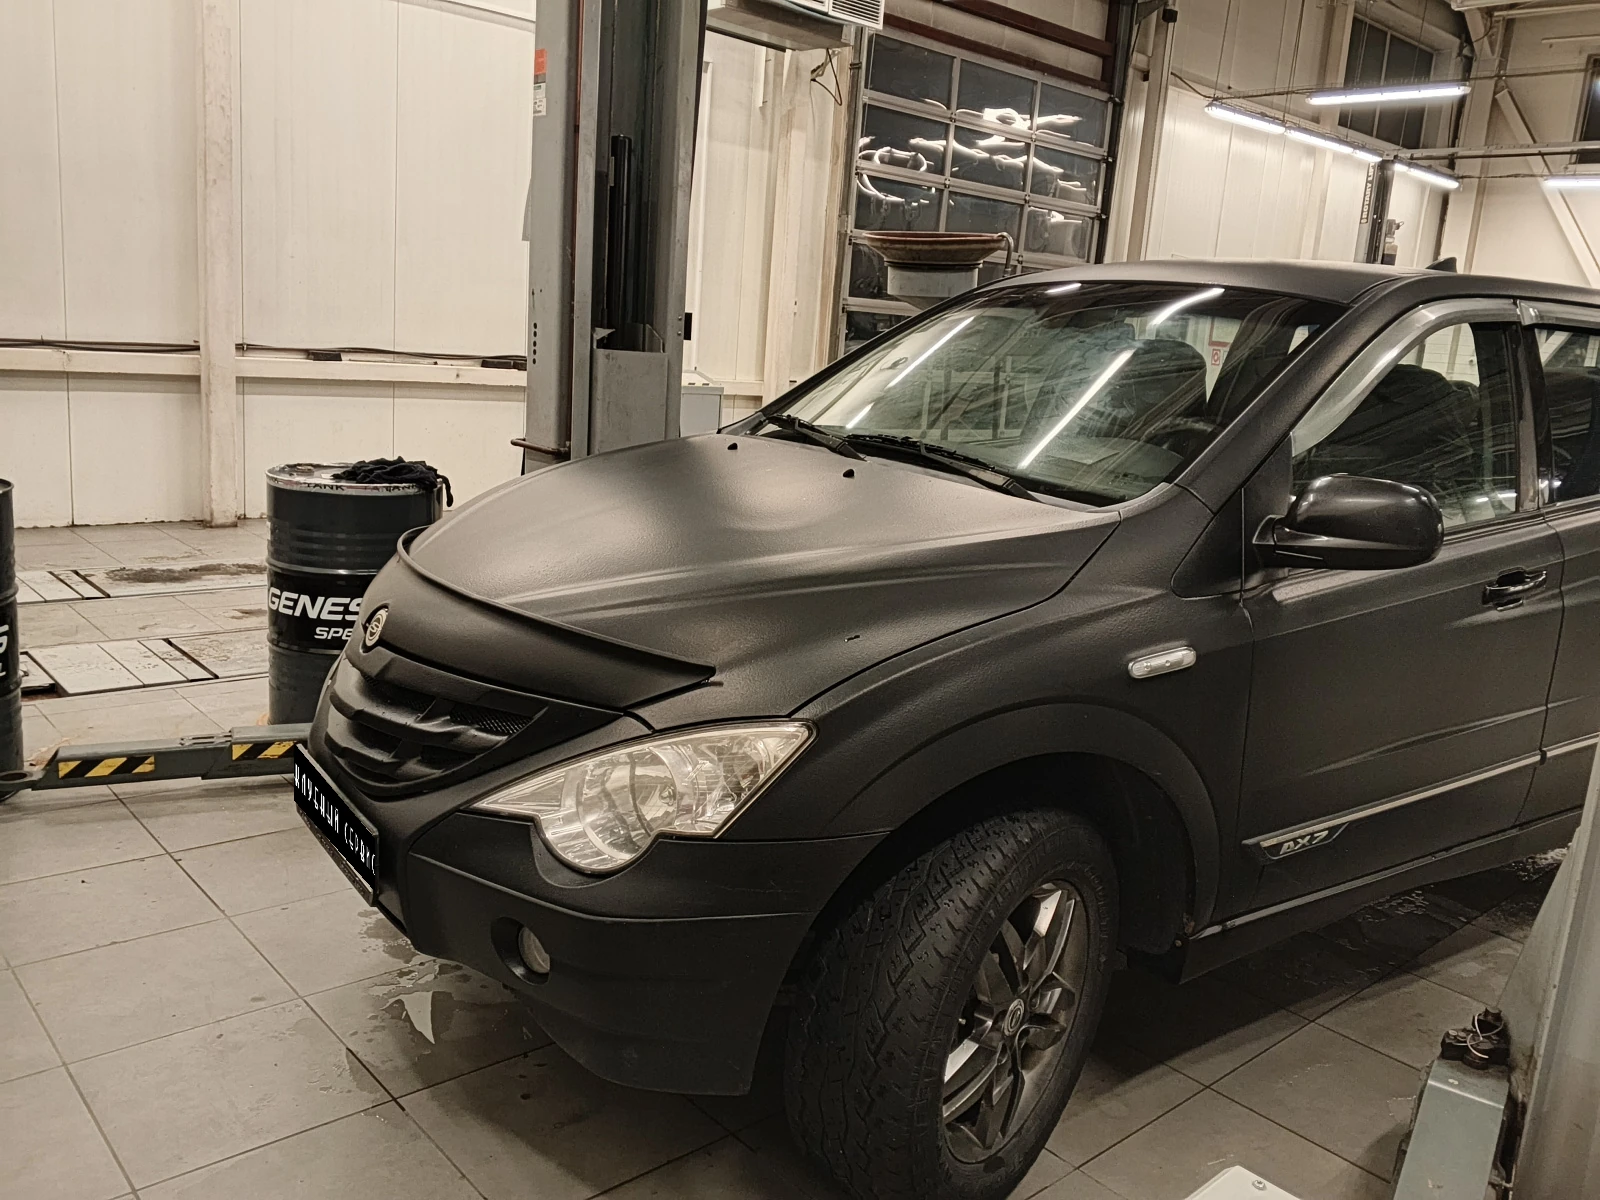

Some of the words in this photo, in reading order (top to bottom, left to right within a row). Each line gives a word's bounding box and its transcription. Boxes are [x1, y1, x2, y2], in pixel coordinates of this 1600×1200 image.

[268, 586, 363, 620] GENES
[314, 627, 353, 640] SPE
[1280, 830, 1329, 855] AX7
